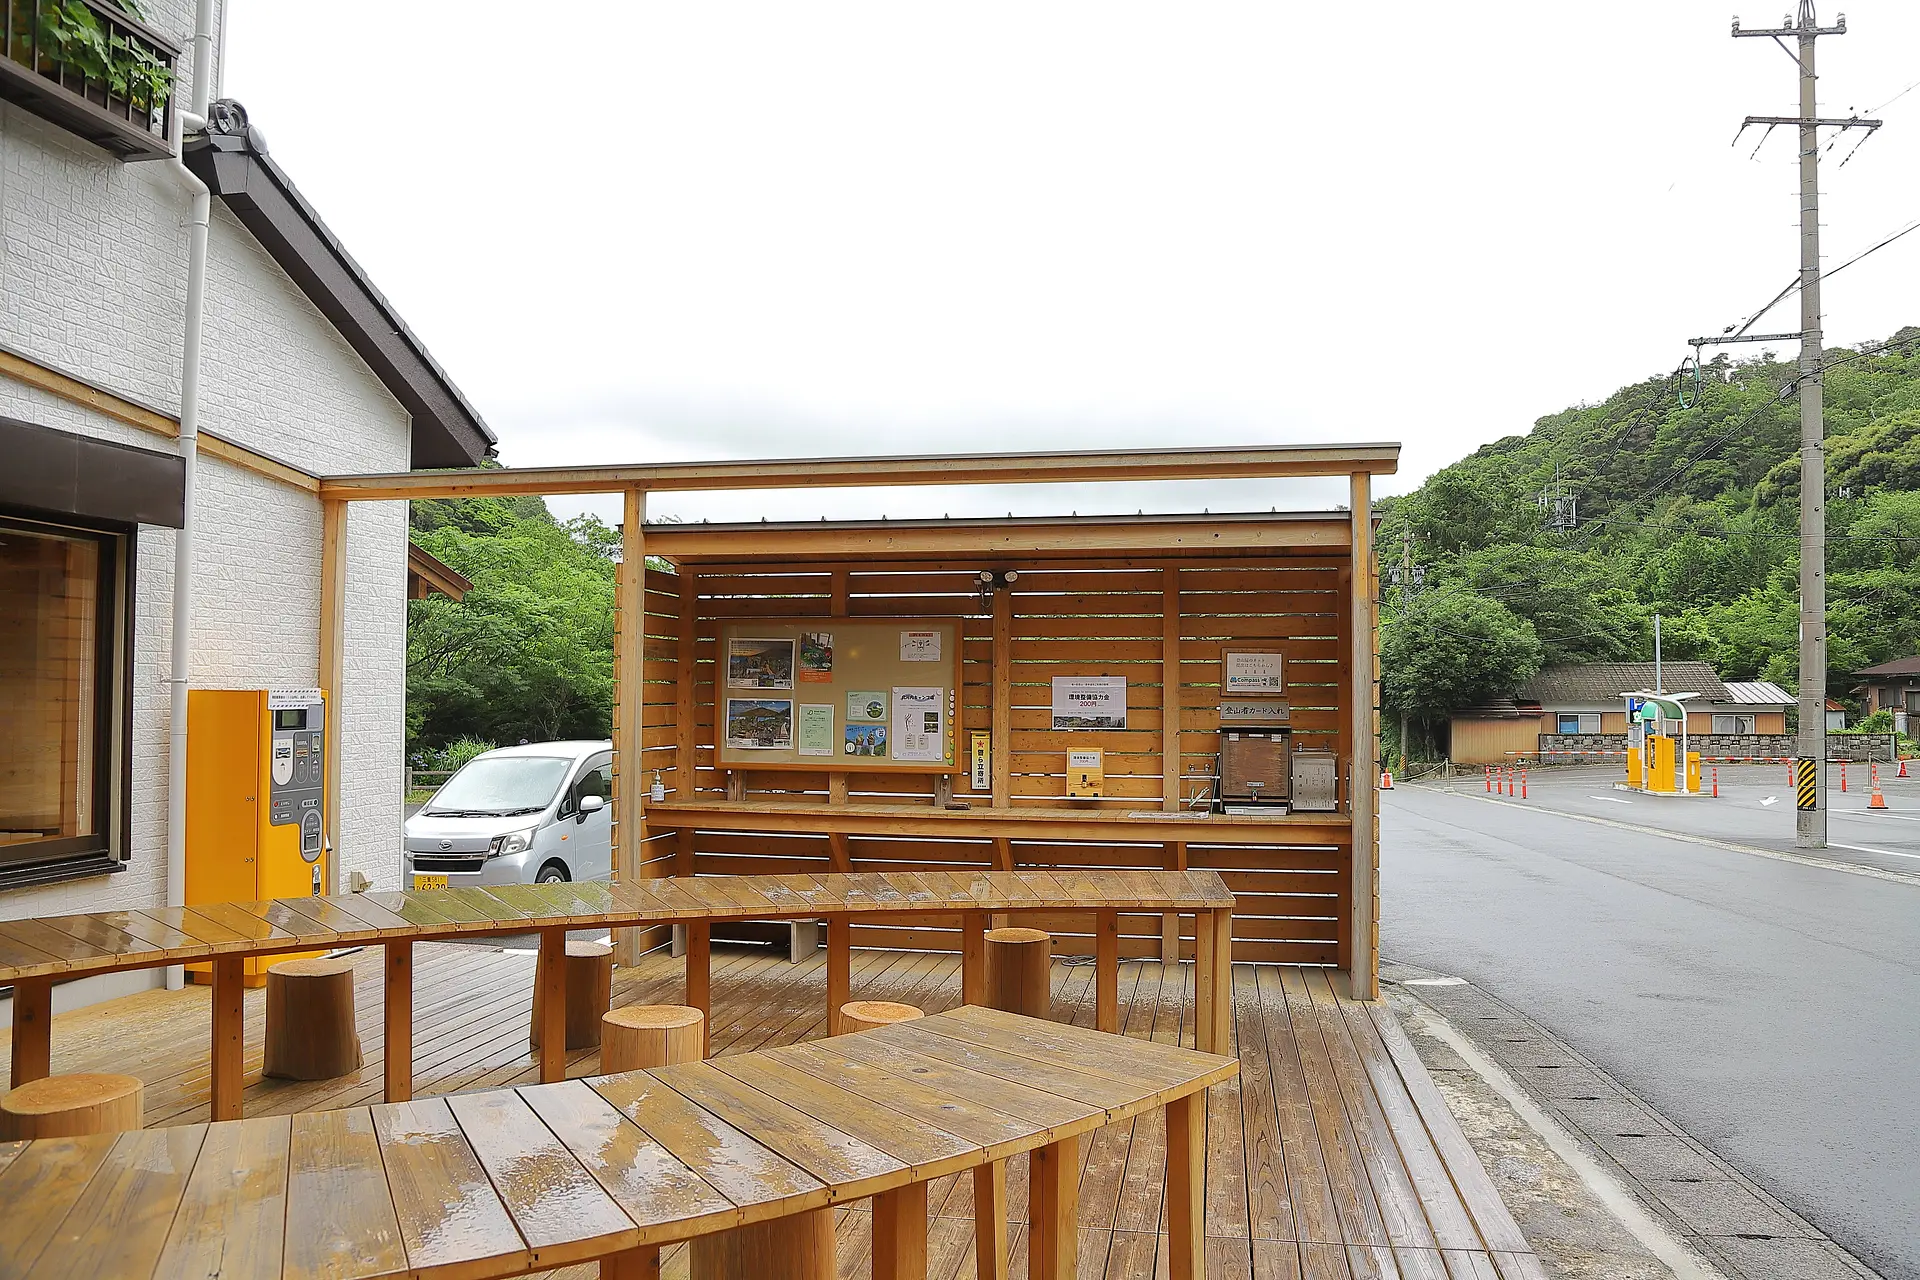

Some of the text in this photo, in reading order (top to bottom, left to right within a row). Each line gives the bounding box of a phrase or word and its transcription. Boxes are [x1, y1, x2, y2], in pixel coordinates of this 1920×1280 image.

[1237, 676, 1261, 684] Compass
[1068, 693, 1110, 701] 環境整備協力金
